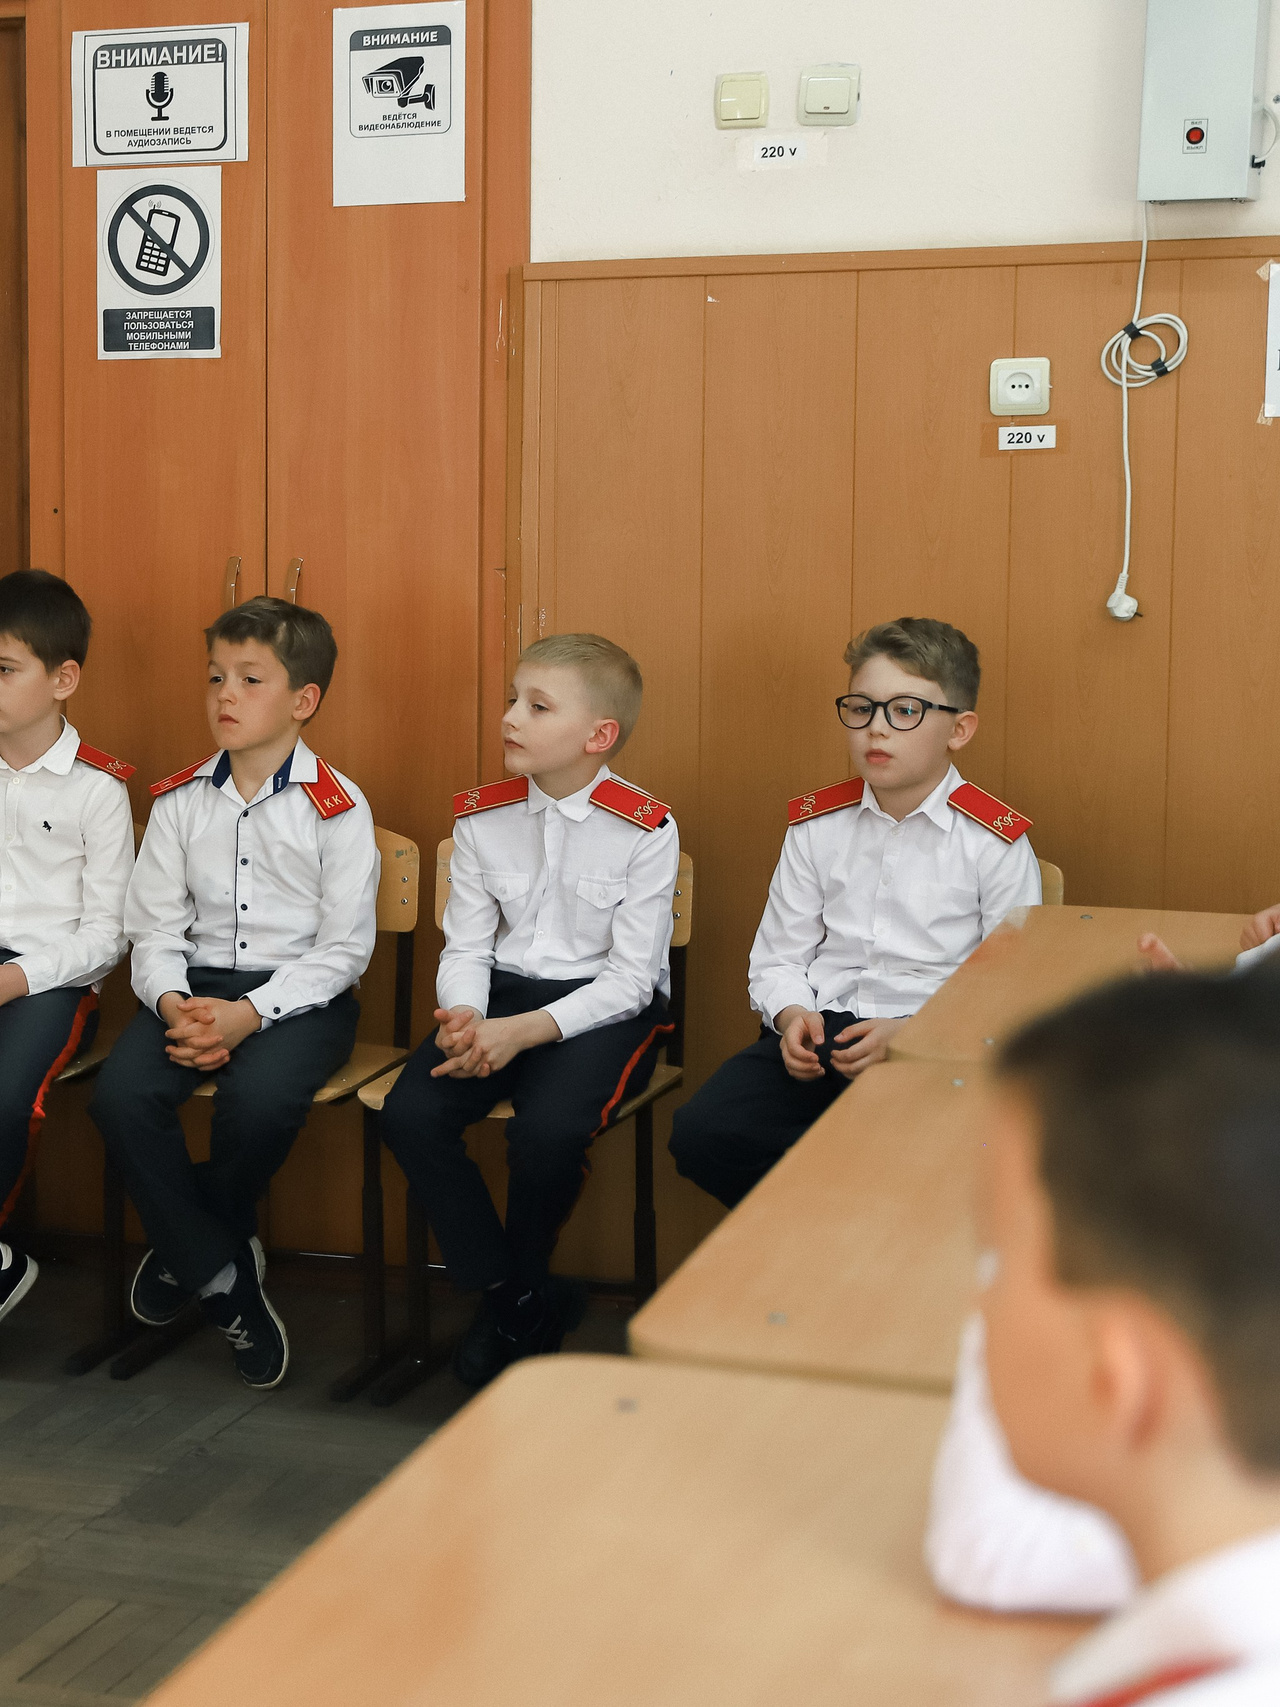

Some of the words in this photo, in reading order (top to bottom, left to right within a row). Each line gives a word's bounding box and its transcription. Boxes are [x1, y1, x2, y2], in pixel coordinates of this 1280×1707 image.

[362, 30, 439, 47] ВНИМАНИЕ
[96, 43, 223, 69] ВНИМАНИЕ!
[382, 111, 418, 122] ВЕДЁТСЯ
[105, 130, 112, 138] В
[114, 127, 171, 138] ПОМЕЩЕНИИ
[173, 125, 214, 136] ВЕДЕТСЯ
[358, 120, 442, 132] ВИДЕОНАБЛЮДЕНИЕ
[127, 137, 192, 148] АУДИОЗАПИСЬ
[761, 145, 785, 158] 220
[125, 310, 192, 320] ЗАПРЕЩАЕТСЯ
[123, 320, 194, 330] ПОЛЬЗОВАТЬСЯ
[126, 331, 192, 341] МОБИЛЬНЫМИ
[128, 342, 190, 351] ТЕЛЕФОНАМИ
[1007, 432, 1032, 444] 220
[323, 794, 344, 809] КК
